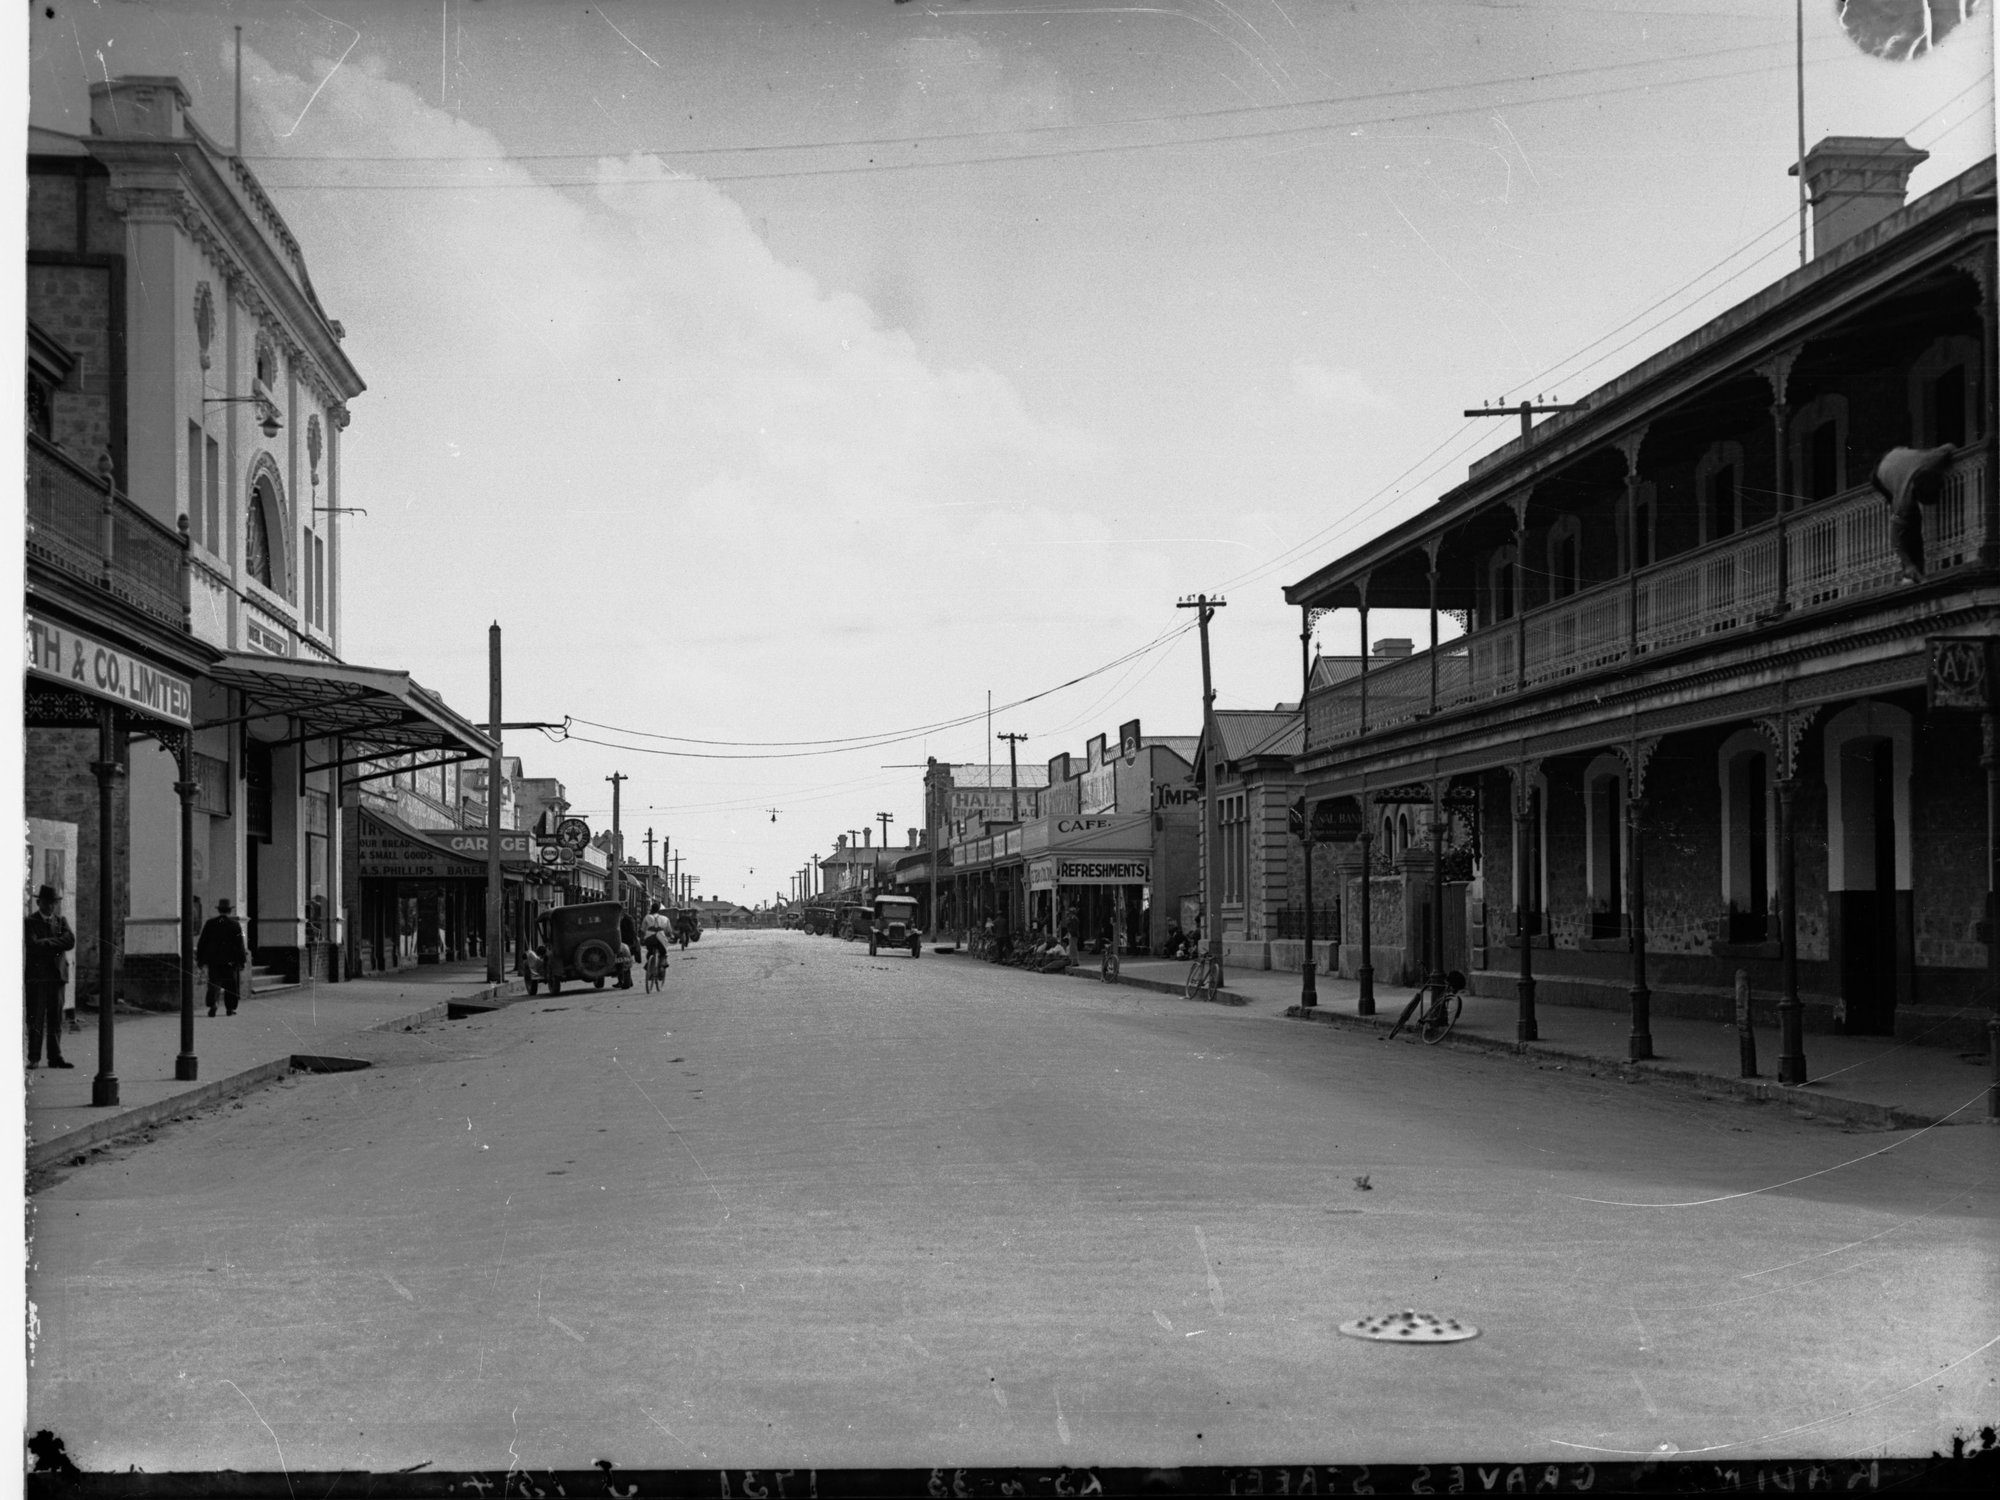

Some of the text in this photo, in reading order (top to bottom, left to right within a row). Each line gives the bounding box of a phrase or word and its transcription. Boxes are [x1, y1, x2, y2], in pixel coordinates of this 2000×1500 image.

[71, 639, 85, 682] &
[129, 661, 190, 719] LIMITED
[955, 793, 1006, 807] HALL
[359, 839, 377, 848] OUR
[451, 837, 526, 851] GARGE
[369, 851, 399, 860] SMALL
[1061, 863, 1145, 878] REFRESHMENTS
